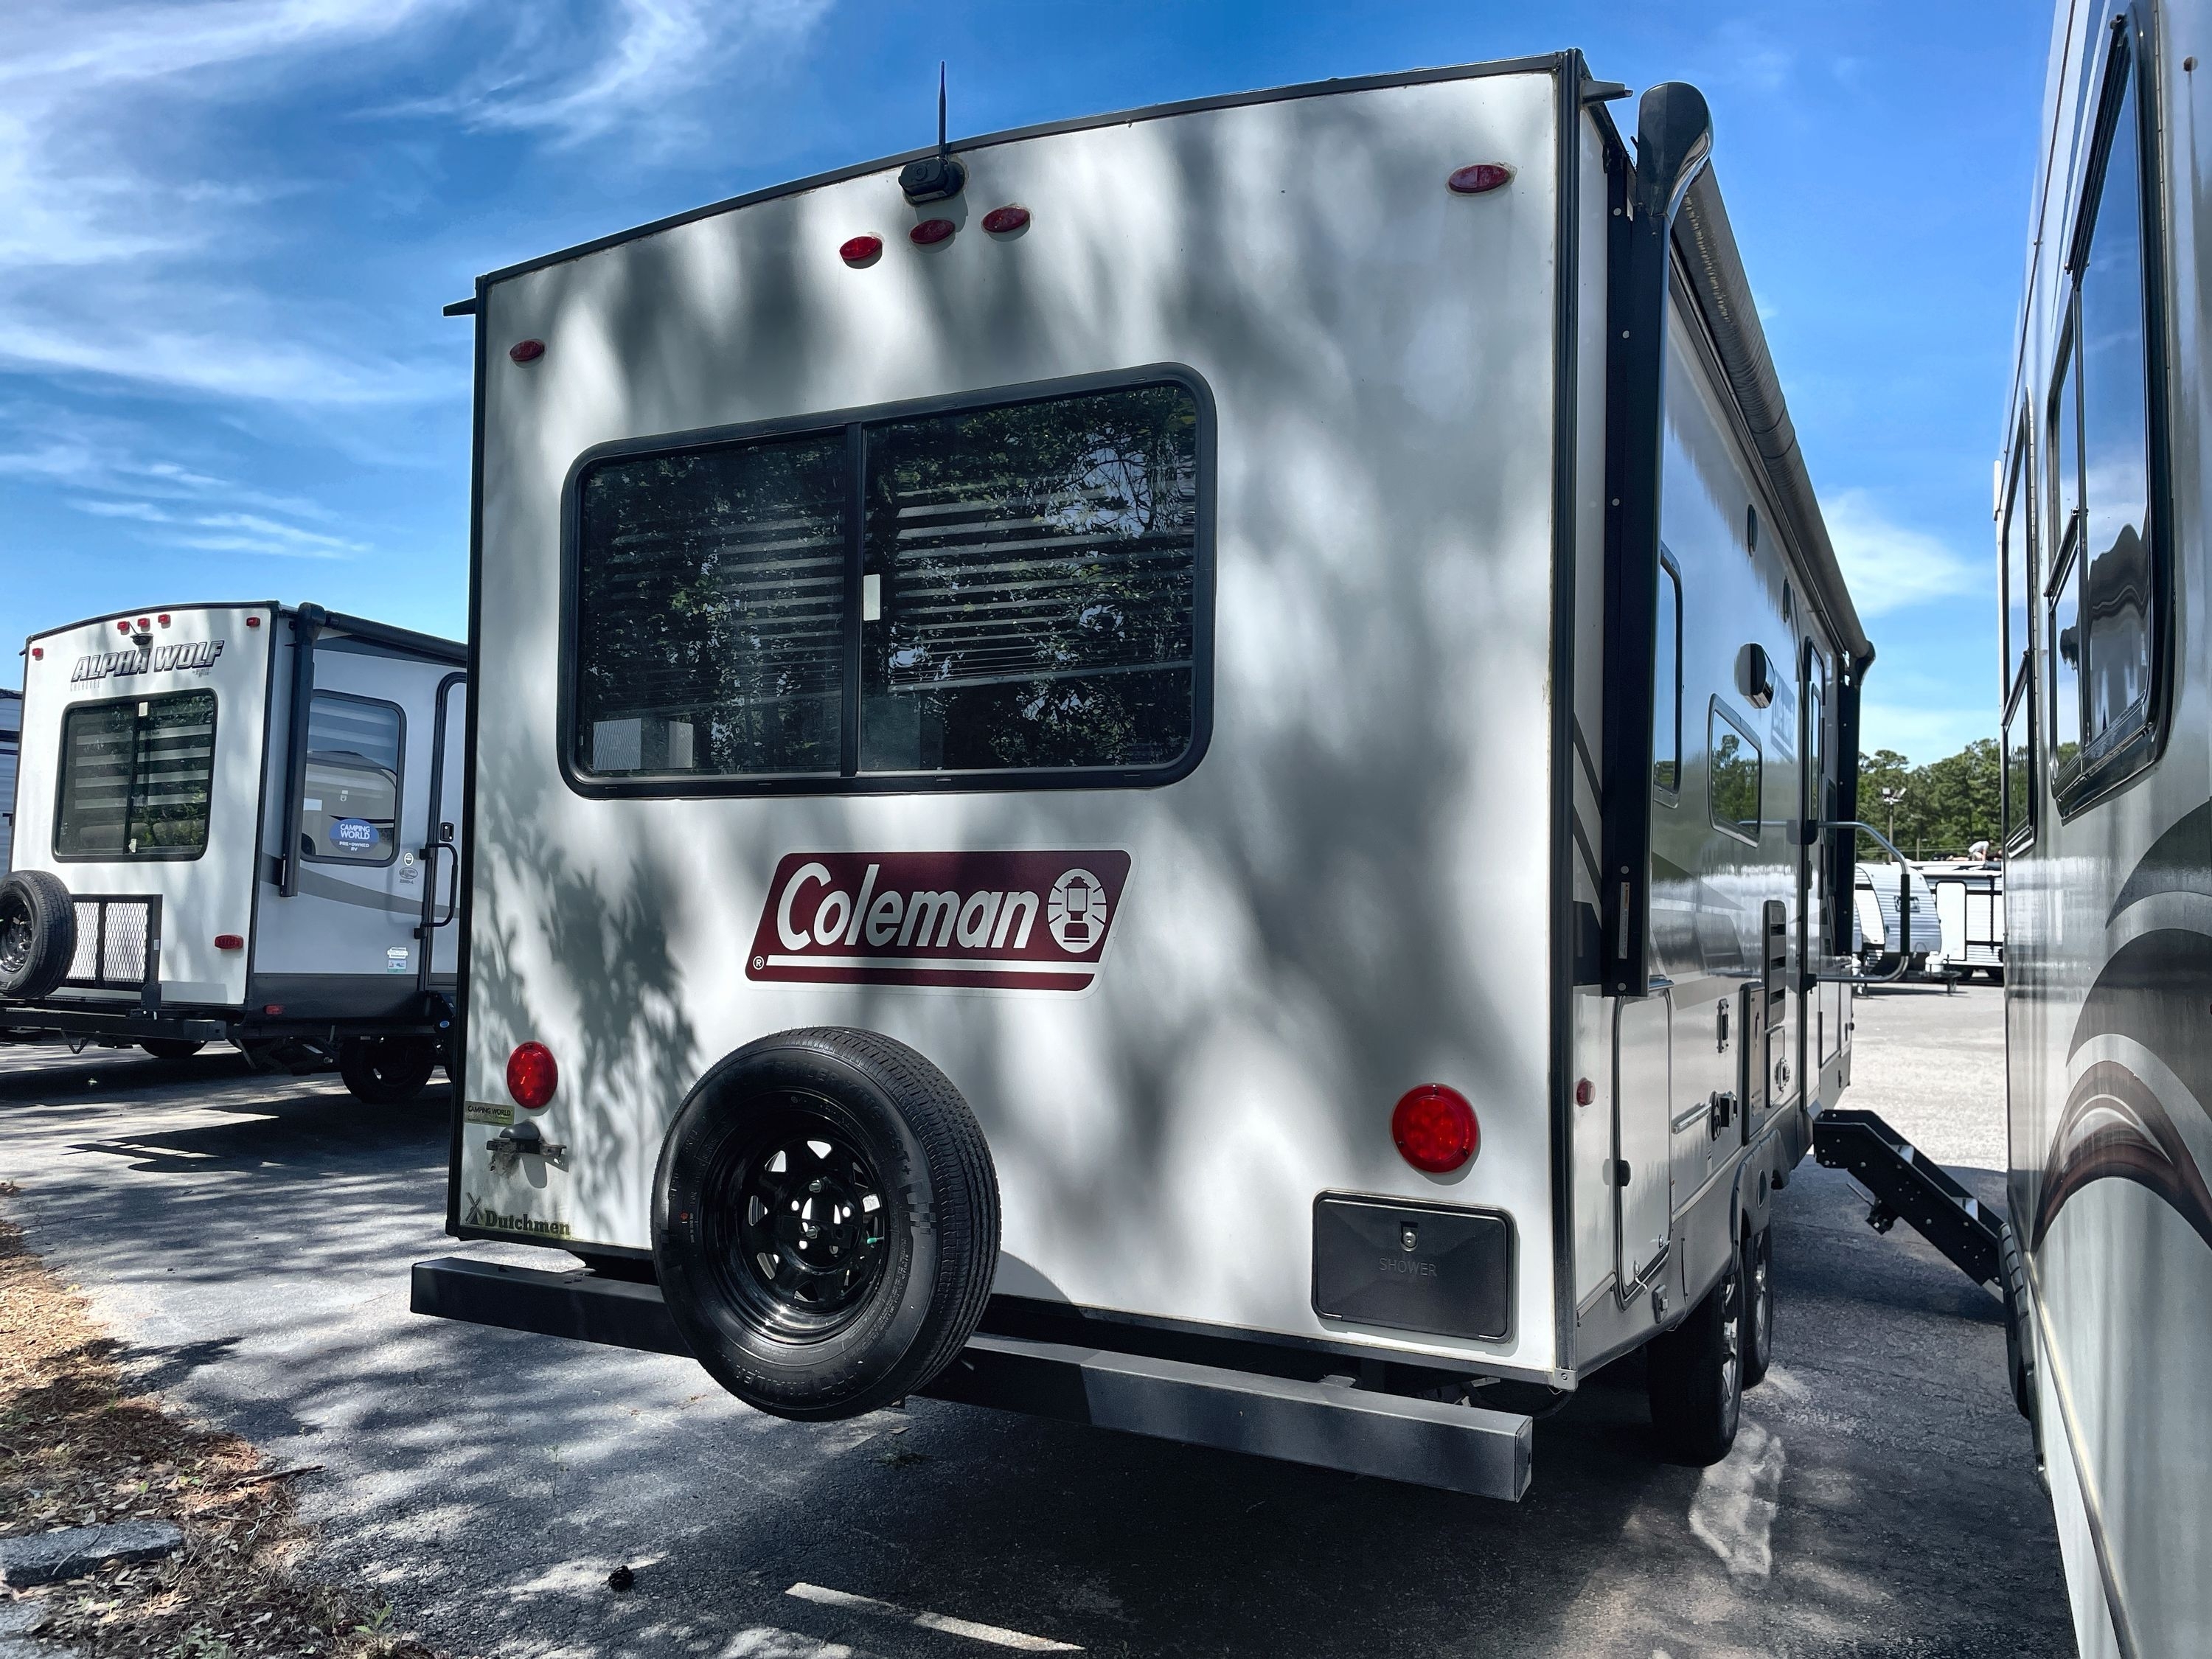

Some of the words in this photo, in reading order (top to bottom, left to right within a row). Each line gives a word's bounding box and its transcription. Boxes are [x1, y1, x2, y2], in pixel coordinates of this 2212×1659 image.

[71, 649, 150, 682] ALPHA
[154, 640, 225, 672] WOLF
[340, 824, 370, 832] CAMPING
[340, 830, 370, 840] WORLD
[776, 861, 1040, 951] Coleman
[467, 1105, 491, 1114] CAMPING
[484, 1207, 570, 1236] Dutchmen
[1379, 1257, 1437, 1277] SHOWER
